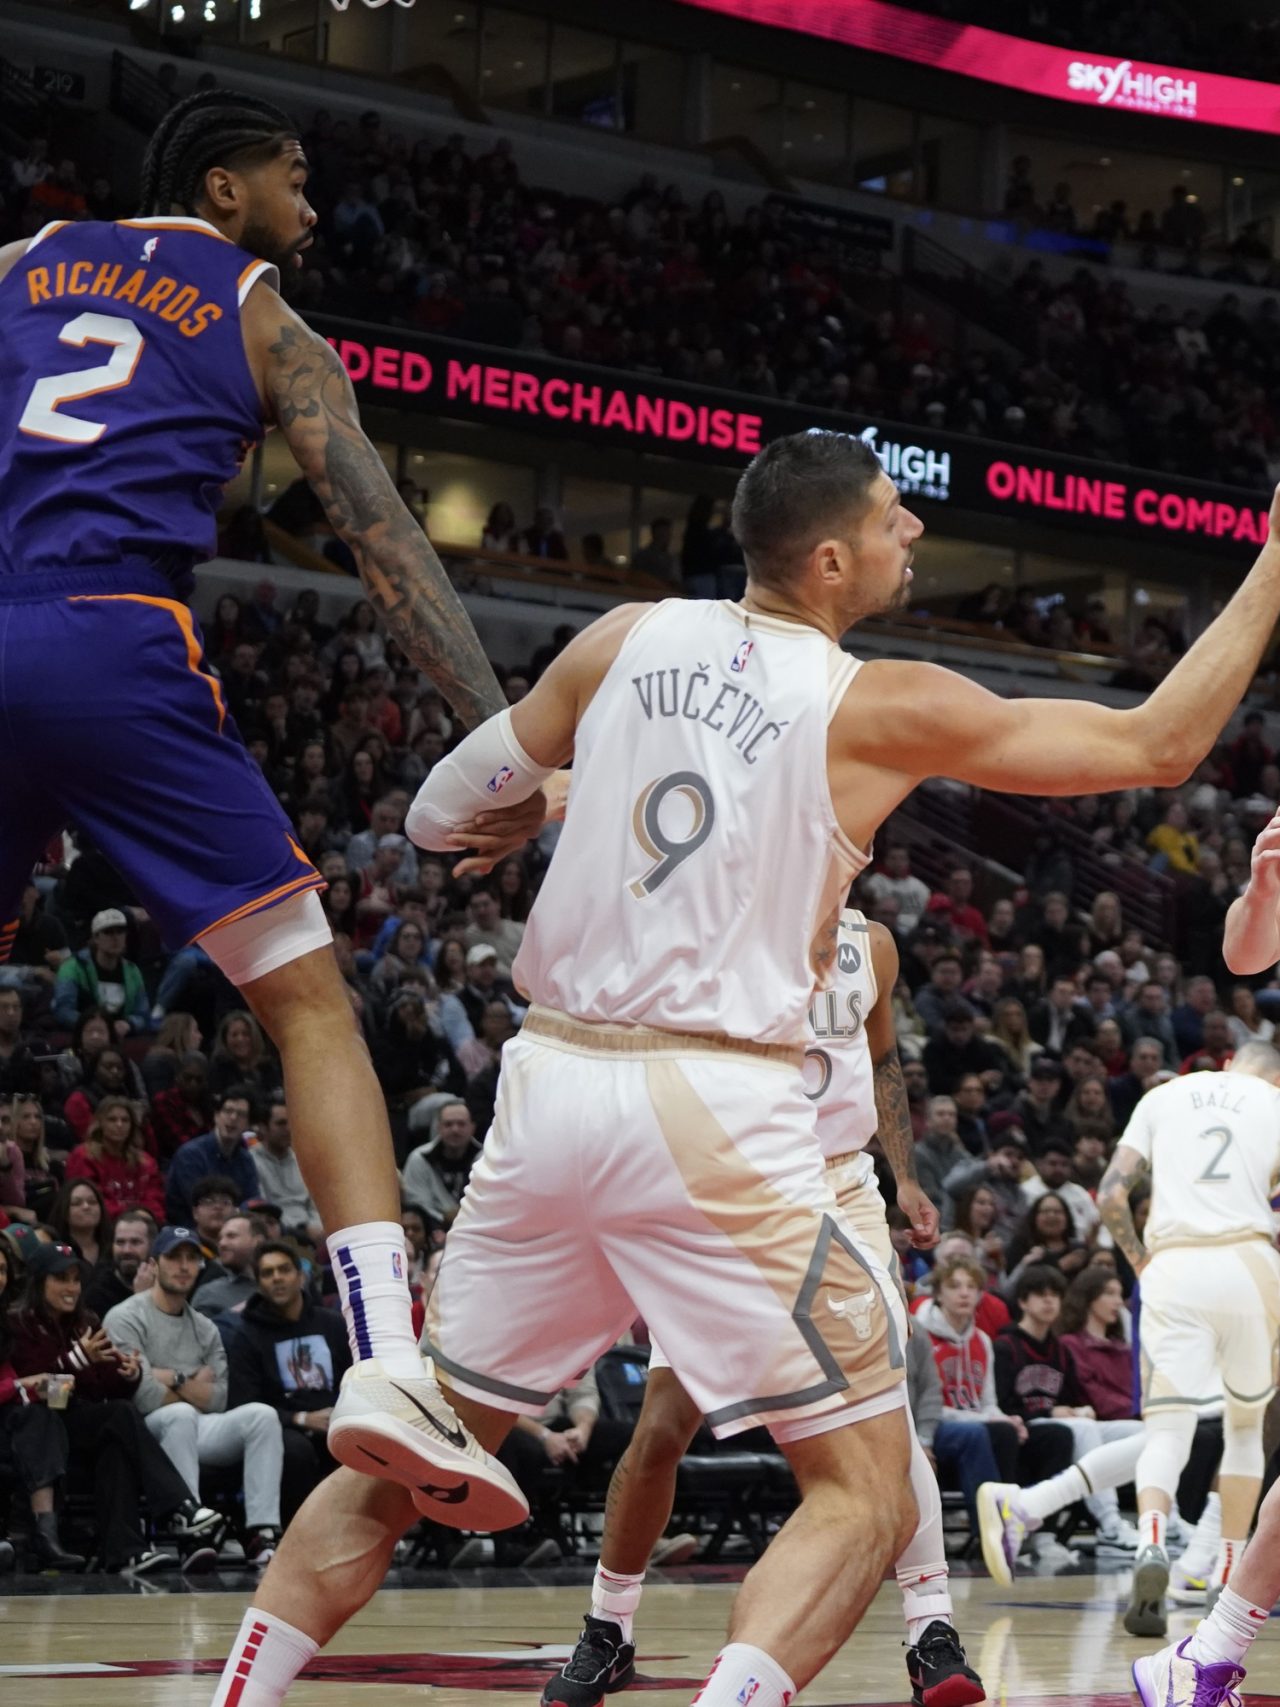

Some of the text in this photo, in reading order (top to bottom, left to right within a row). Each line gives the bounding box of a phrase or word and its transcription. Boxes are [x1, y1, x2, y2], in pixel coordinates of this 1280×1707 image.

[1067, 60, 1197, 105] SKYHIGH
[27, 261, 223, 337] RICHARDS
[18, 312, 145, 443] 2
[327, 337, 762, 454] DED MERCHANDISE
[986, 461, 1126, 519] ONLINE
[632, 662, 789, 765] VUČEVIĆ
[628, 770, 715, 899] 9
[1190, 1091, 1246, 1114] BALL
[1194, 1126, 1233, 1183] 2
